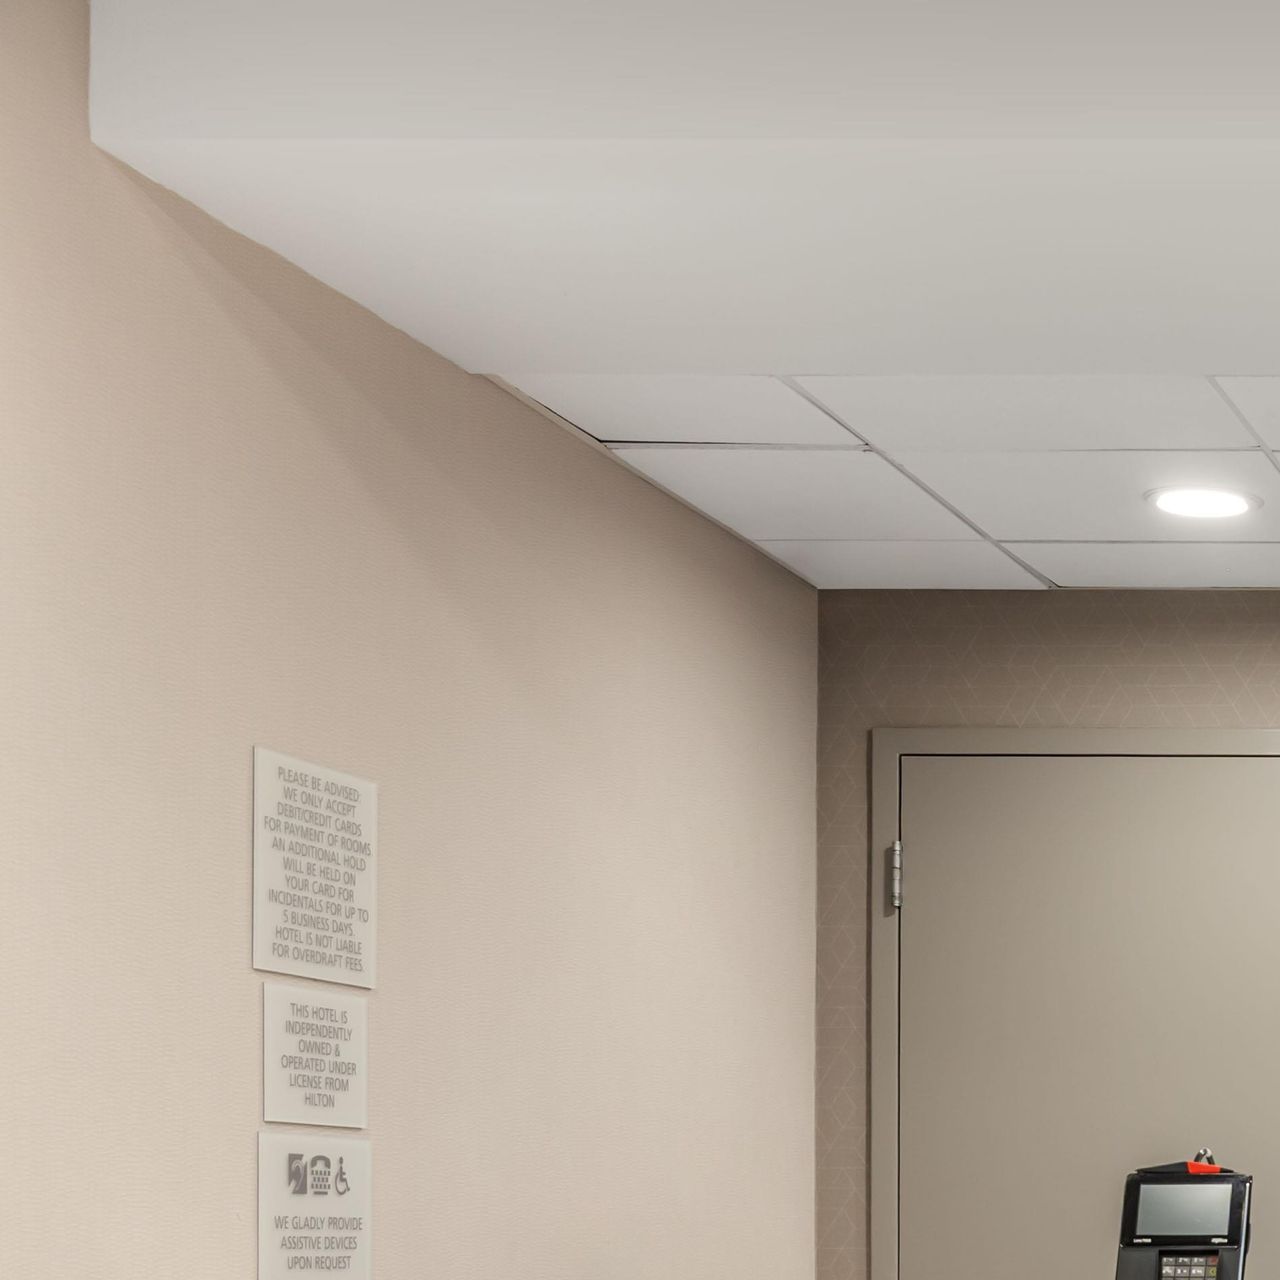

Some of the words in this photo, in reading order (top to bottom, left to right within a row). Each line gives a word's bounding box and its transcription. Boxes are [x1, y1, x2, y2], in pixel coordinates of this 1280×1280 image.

[278, 766, 309, 788] PLEASE
[312, 776, 322, 791] BE
[283, 786, 298, 802] WE
[300, 791, 324, 808] ONLY
[325, 799, 356, 818] ACCEPT
[264, 816, 282, 833] FOR
[284, 821, 325, 843] PAYMENT
[327, 833, 338, 846] OF
[277, 802, 332, 829] DEBIT/CREDIT
[335, 818, 362, 837] CARDS
[272, 836, 285, 852] AN
[288, 840, 341, 866] ADDITIONAL
[343, 854, 366, 871] HOLD
[283, 856, 304, 874] WILL
[306, 862, 317, 877] BE
[320, 866, 341, 882] HELD
[343, 871, 356, 886] ON
[285, 874, 309, 892] YOUR
[312, 881, 336, 898] CARD
[338, 886, 354, 902] FOR
[268, 888, 323, 912] INCIDENTALS
[325, 901, 342, 917] FOR
[345, 905, 356, 919] UP
[357, 908, 369, 922] TO
[291, 911, 329, 931] BUSINESS
[275, 925, 304, 944] HOTEL
[306, 932, 313, 946] IS
[315, 934, 333, 949] NOT
[336, 937, 362, 955] LIABLE
[272, 942, 290, 959] FOR
[292, 946, 343, 968] OVERDRAFT
[290, 1003, 309, 1018] THIS
[312, 1007, 338, 1023] HOTEL
[341, 1011, 348, 1024] IS
[285, 1020, 353, 1041] INDEPENDENTLY
[298, 1039, 332, 1056] OWNED
[334, 1044, 341, 1057] &
[281, 1054, 326, 1072] OPERATED
[328, 1060, 357, 1075] UNDER
[289, 1073, 322, 1089] LICENSE
[324, 1077, 349, 1092] FROM
[304, 1092, 335, 1108] HILTON
[274, 1216, 289, 1229] WE
[291, 1216, 325, 1230] GLADLY
[327, 1216, 363, 1230] PROVIDE
[280, 1236, 322, 1250] ASSISTIVE
[324, 1236, 358, 1250] DEVICES
[287, 1256, 312, 1270] UPON
[314, 1256, 352, 1270] REQUEST
